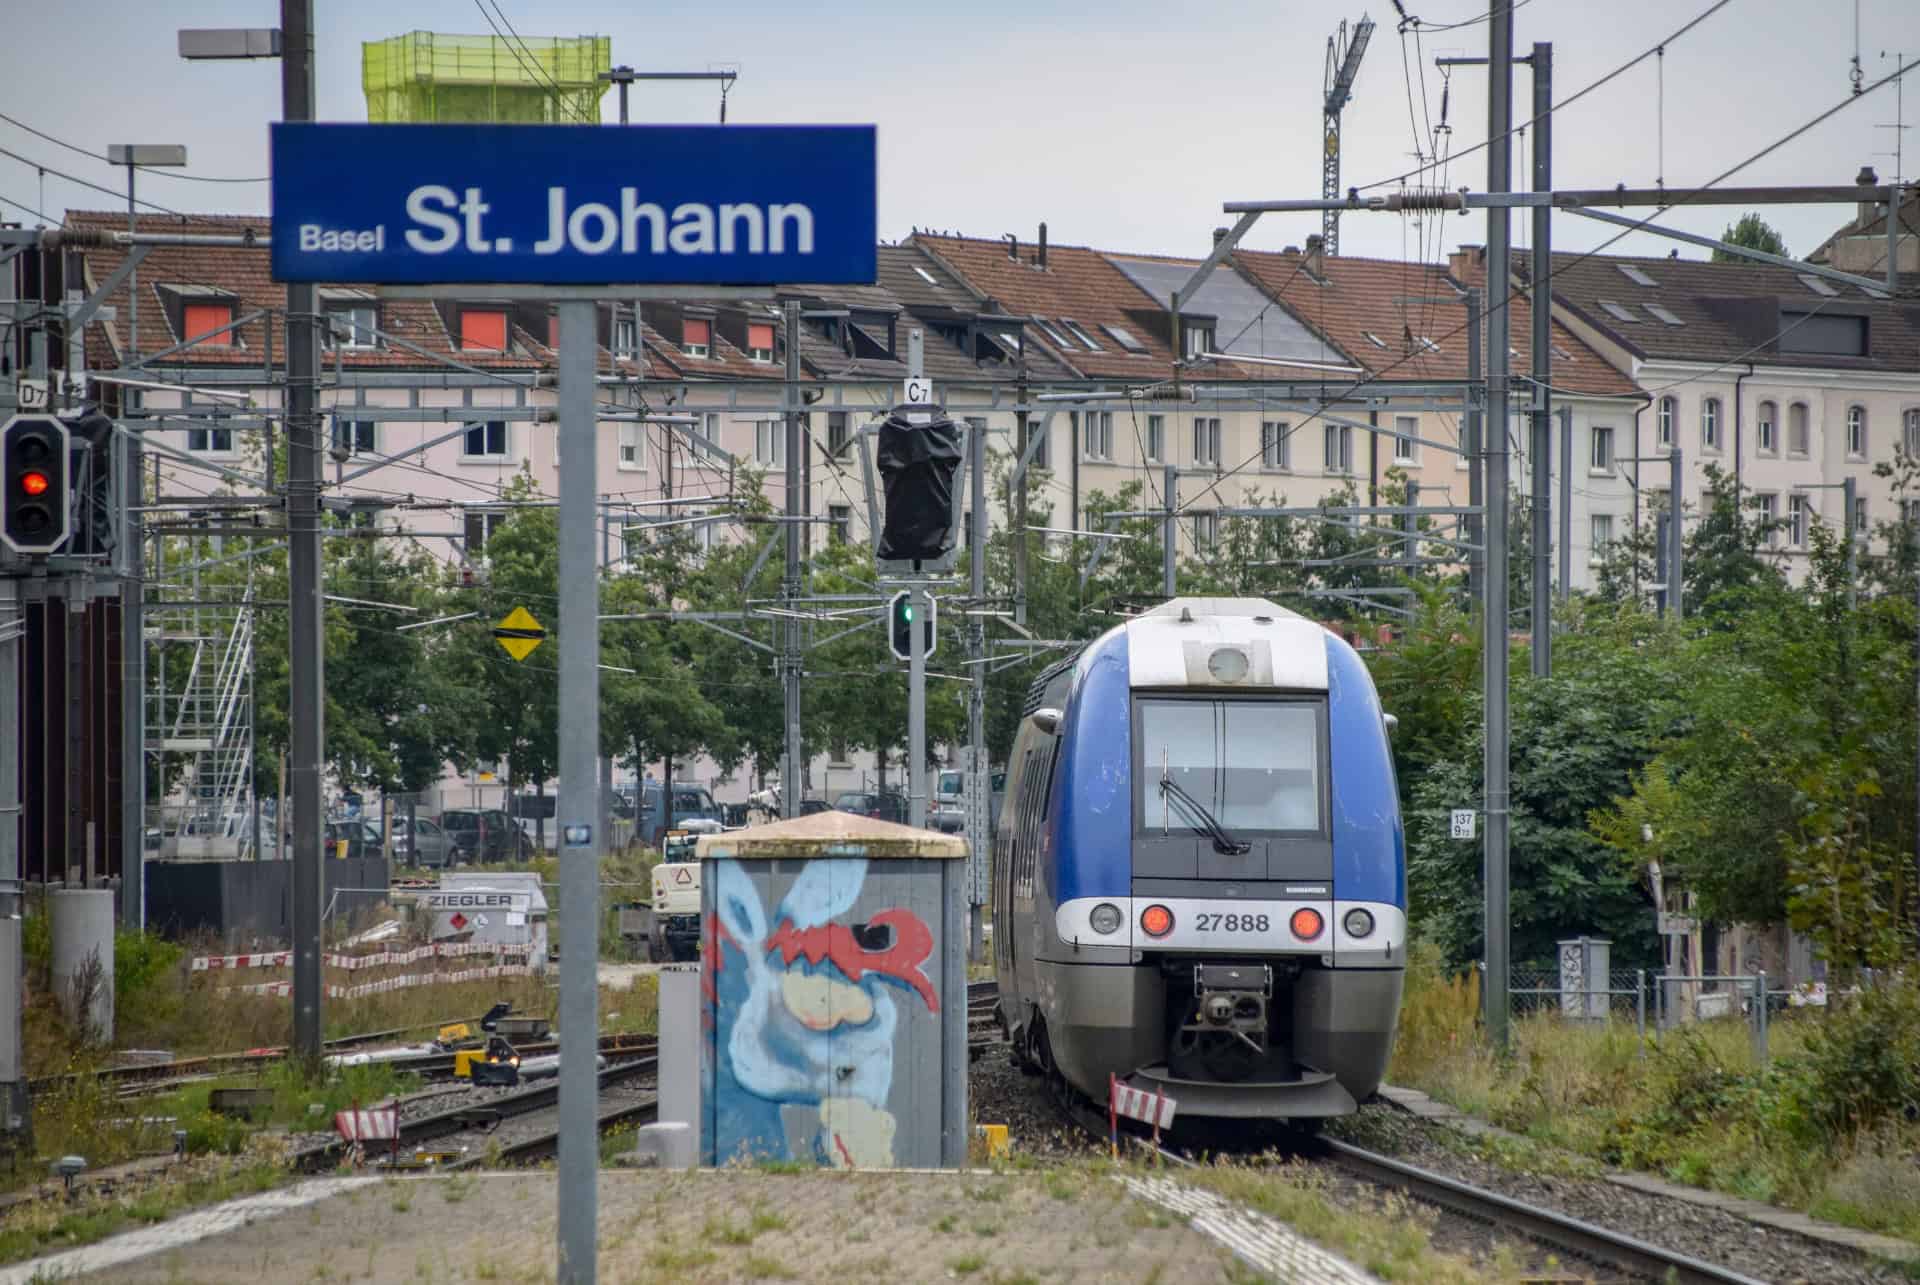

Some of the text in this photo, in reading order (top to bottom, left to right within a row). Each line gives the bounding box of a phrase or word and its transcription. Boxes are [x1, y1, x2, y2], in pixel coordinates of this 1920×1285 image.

[299, 184, 814, 254] Basel St. Johann
[1455, 814, 1472, 824] 137
[431, 895, 512, 906] ZIEGLER
[1195, 913, 1270, 932] 27888
